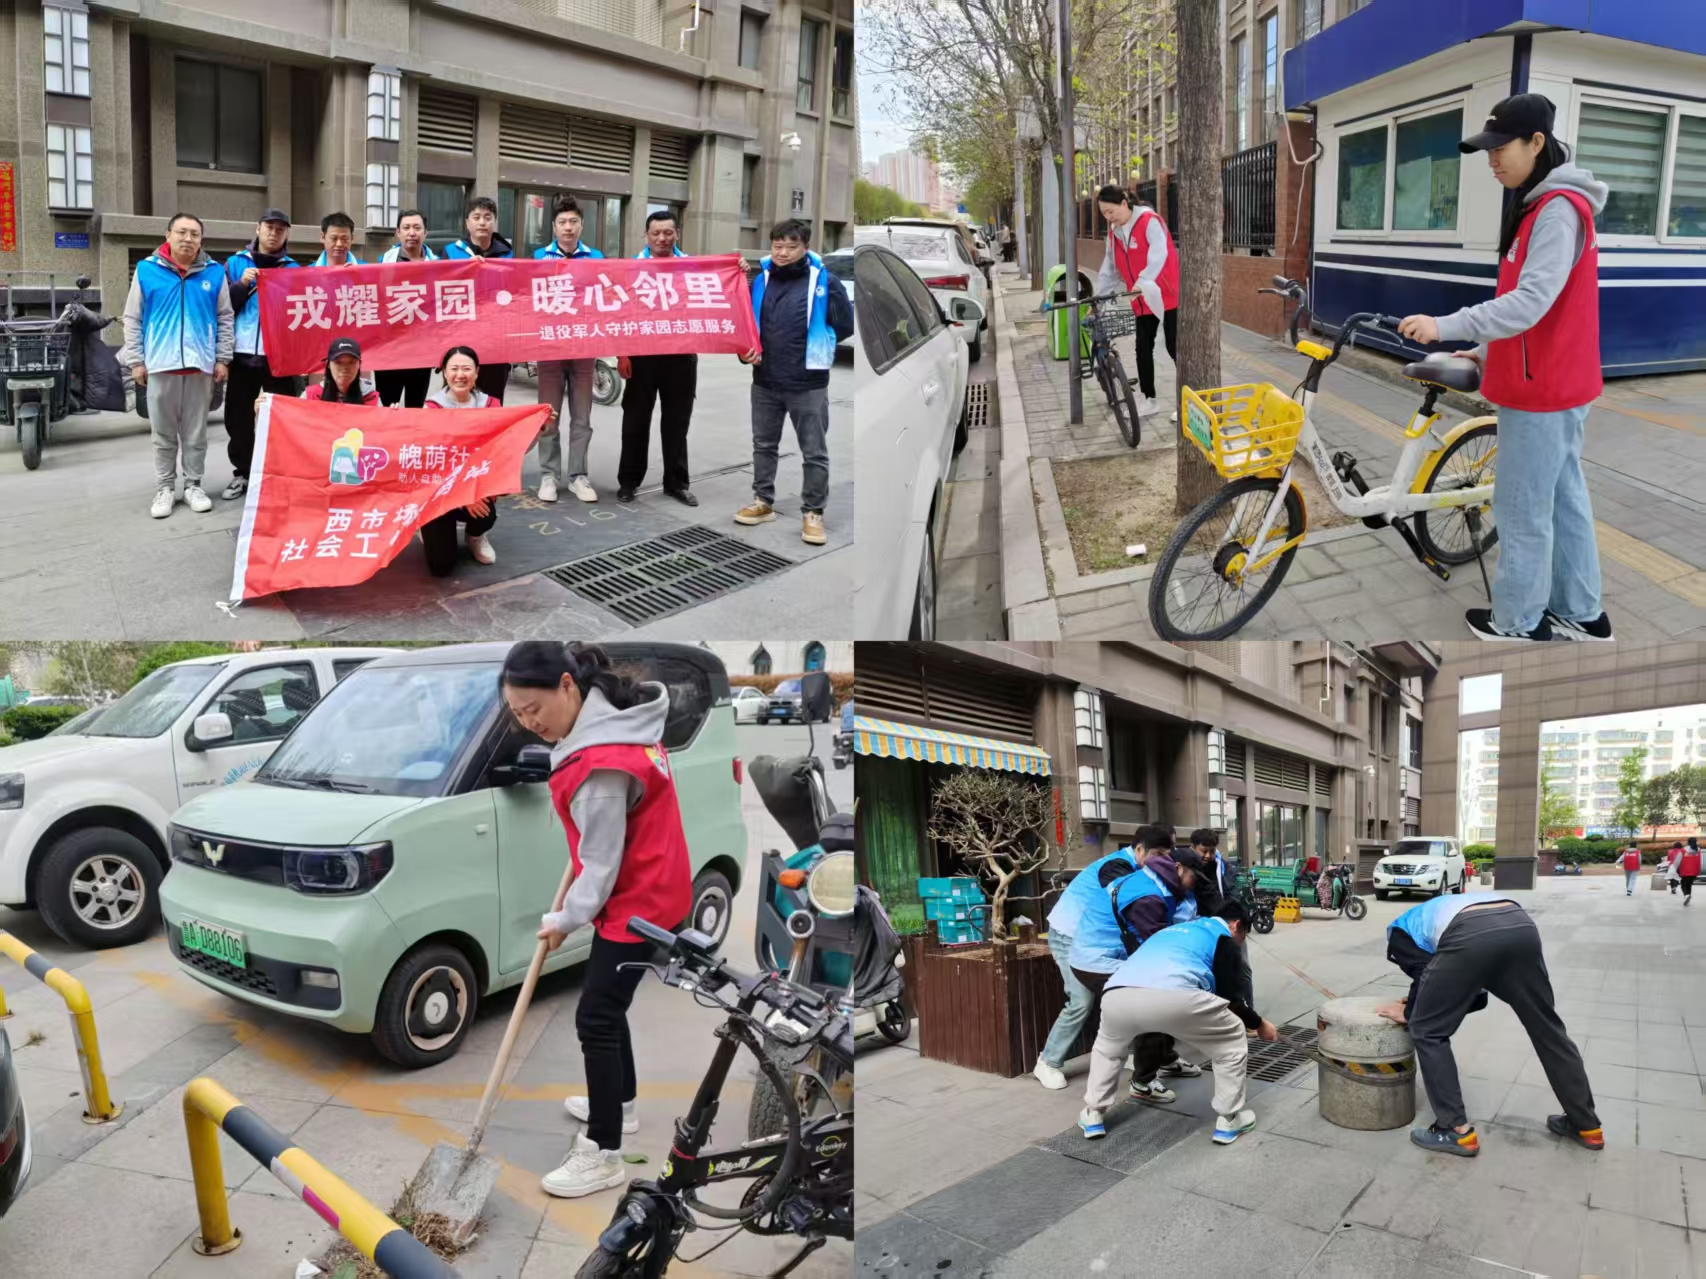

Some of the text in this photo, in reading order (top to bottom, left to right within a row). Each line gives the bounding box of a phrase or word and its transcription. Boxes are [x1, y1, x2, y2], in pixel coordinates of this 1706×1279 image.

[398, 443, 482, 475] 槐荫社
[281, 530, 400, 563] 社会工
